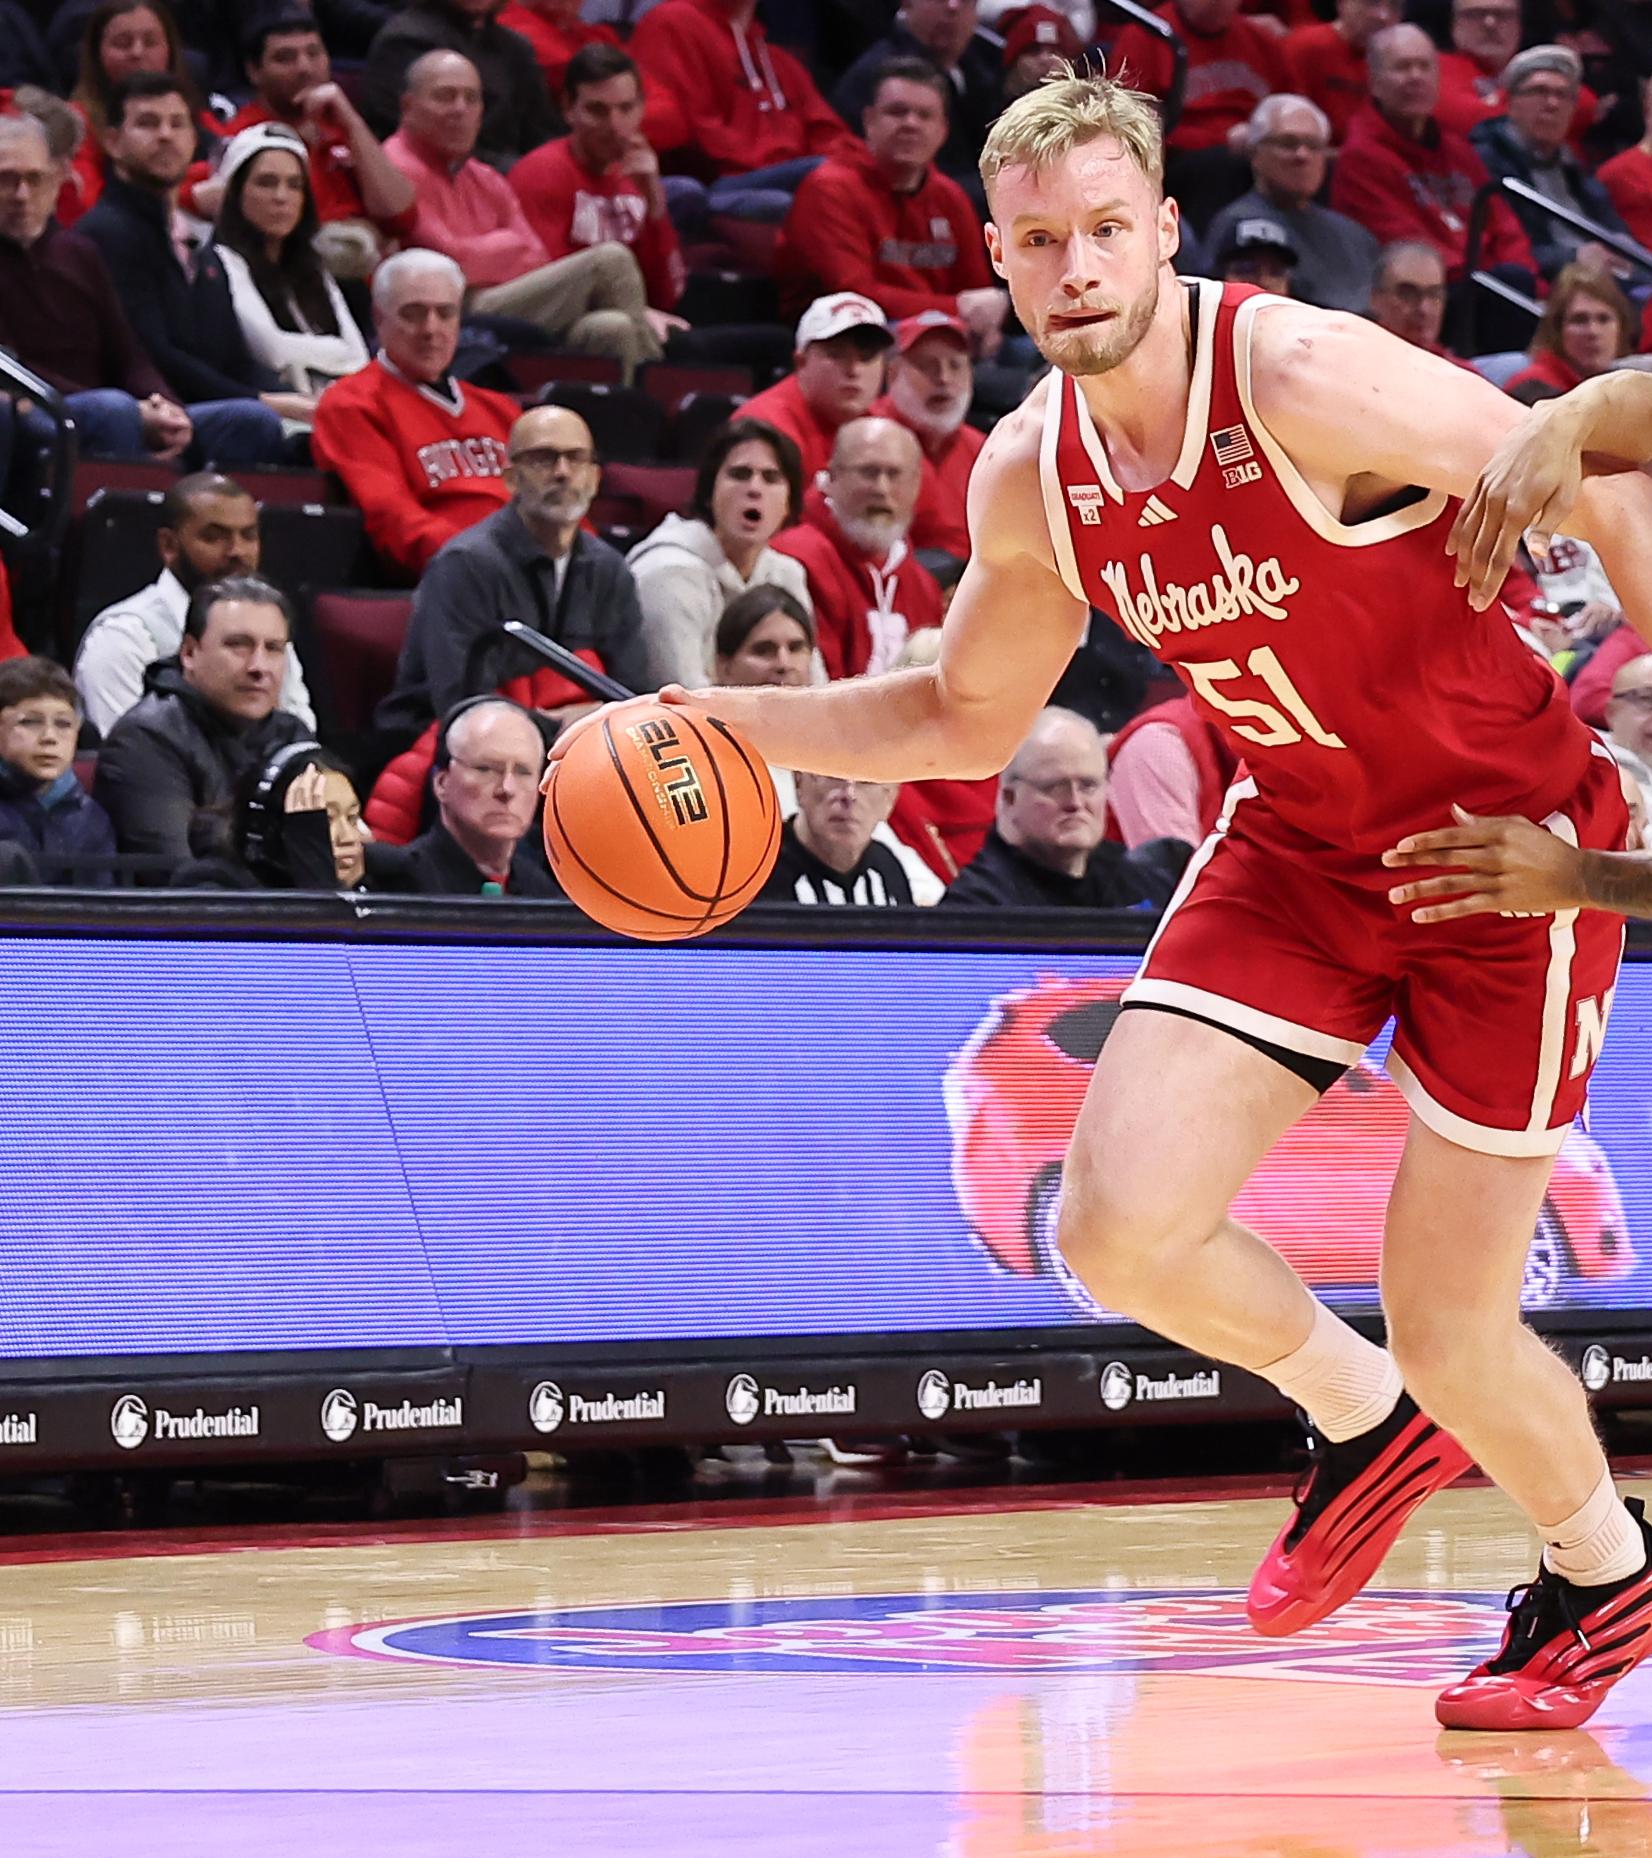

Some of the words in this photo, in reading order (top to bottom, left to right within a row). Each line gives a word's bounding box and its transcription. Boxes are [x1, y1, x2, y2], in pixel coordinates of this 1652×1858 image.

[1100, 523, 1300, 650] Nebraska
[1178, 645, 1348, 749] 51
[637, 718, 710, 826] ELITE
[765, 1384, 856, 1416] Prudential
[953, 1378, 1041, 1410] Prudential
[1135, 1370, 1220, 1401] Prudential
[154, 1406, 259, 1439] Prudential
[363, 1397, 462, 1431] Prudential
[569, 1390, 665, 1423] Prudential
